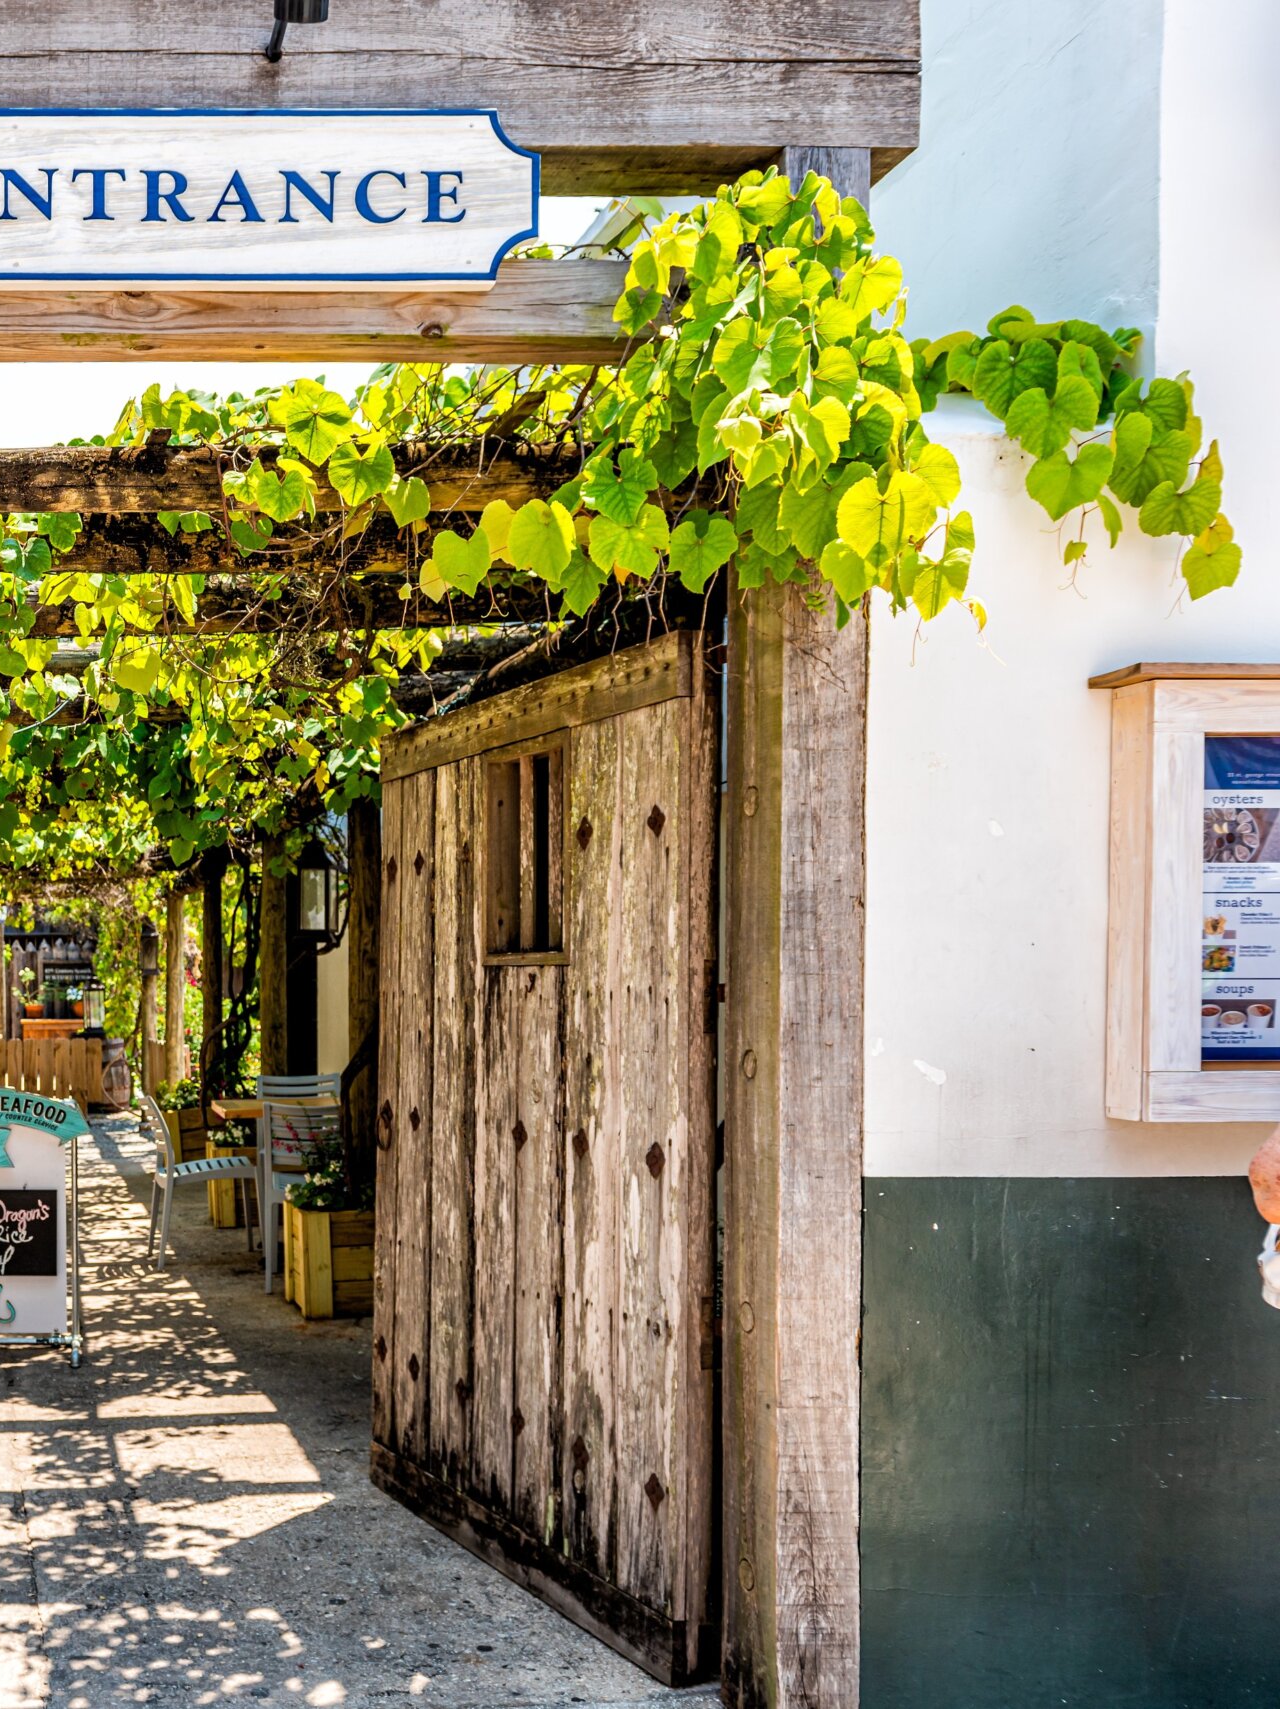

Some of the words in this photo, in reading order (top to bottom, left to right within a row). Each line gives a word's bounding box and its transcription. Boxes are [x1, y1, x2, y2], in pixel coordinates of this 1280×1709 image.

[1212, 794, 1264, 807] oysters
[1215, 896, 1263, 908] snacks
[1215, 985, 1255, 998] soups
[5, 1114, 32, 1123] COUNTER
[34, 1118, 59, 1131] SERVICE
